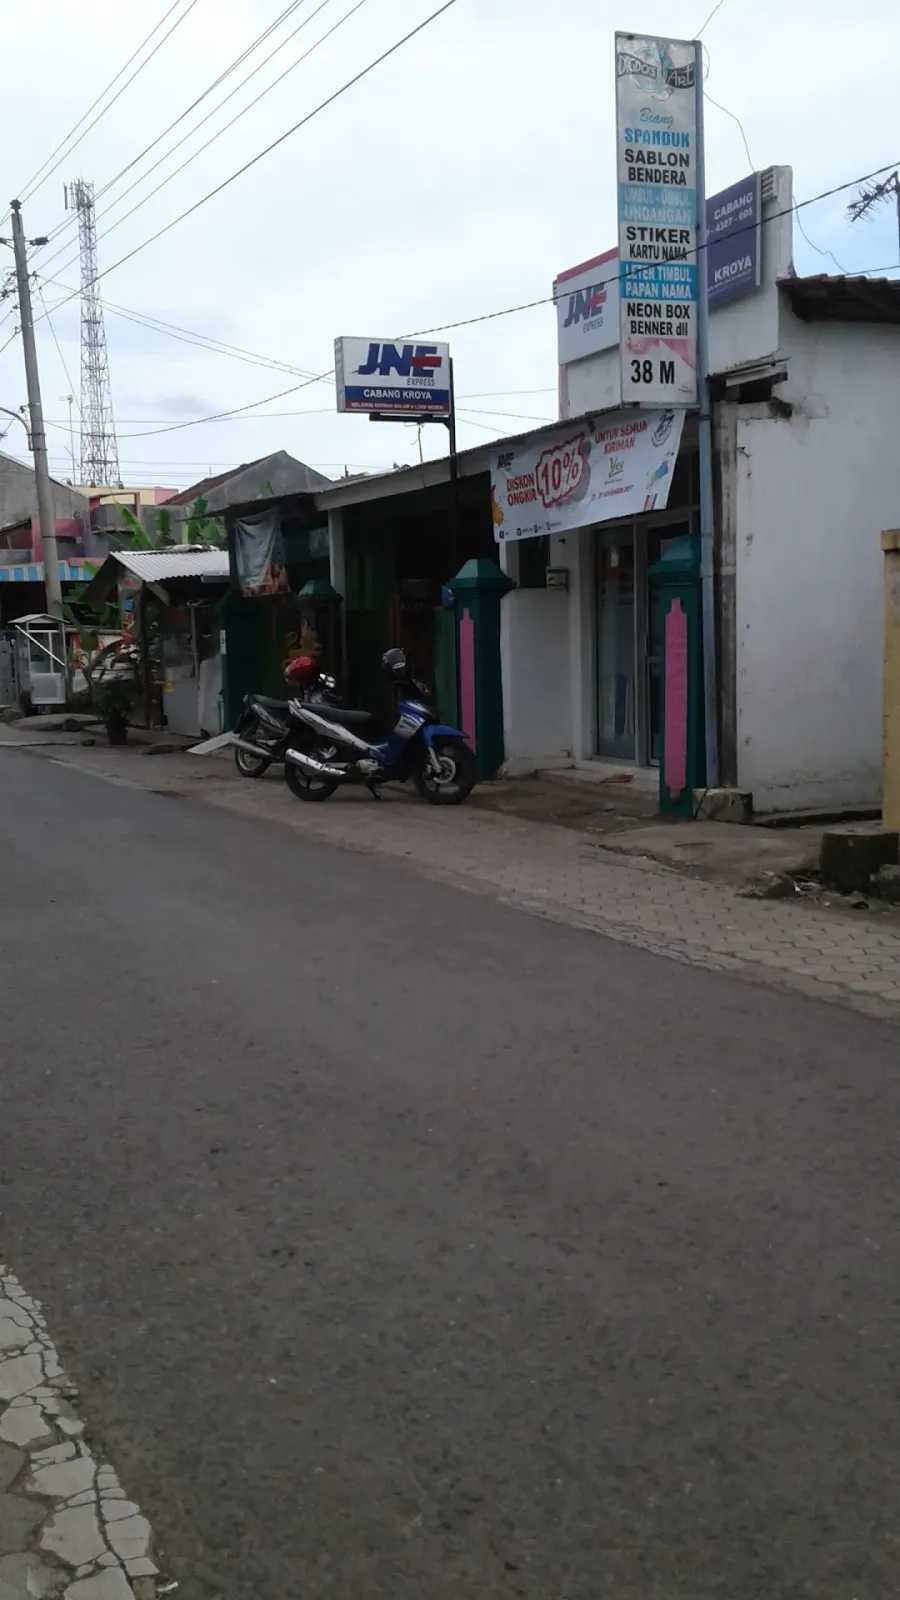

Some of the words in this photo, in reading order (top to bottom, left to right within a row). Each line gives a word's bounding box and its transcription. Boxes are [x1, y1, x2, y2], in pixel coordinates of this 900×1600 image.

[640, 107, 674, 129] Biang
[625, 128, 690, 148] SPANDUK
[625, 149, 690, 167] SABLON
[628, 167, 687, 185] BENDERA
[625, 205, 690, 224] UNDANGAN
[714, 192, 753, 219] CABANG
[626, 226, 690, 244] STIKER
[629, 244, 659, 260] KARTU
[662, 247, 687, 261] NAMA
[658, 267, 692, 281] TIMBUL
[714, 256, 752, 282] KROYA
[625, 283, 658, 297] PAPAN
[662, 285, 692, 298] NAMA
[563, 283, 607, 328] JNE
[627, 302, 661, 317] NEON
[666, 305, 691, 320] BOX
[630, 320, 673, 335] BENNER
[351, 343, 442, 377] JNE
[631, 359, 653, 384] 38
[660, 361, 674, 384] M
[407, 378, 435, 387] EXPRESS
[364, 389, 400, 399] CABANG
[402, 391, 432, 400] KROYA
[594, 427, 620, 443] UNTUK
[620, 420, 648, 437] SEMUA
[604, 437, 636, 455] KIRIMAN
[541, 447, 579, 496] 10%
[506, 473, 534, 492] DISKON
[507, 489, 537, 506] ONGKIR
